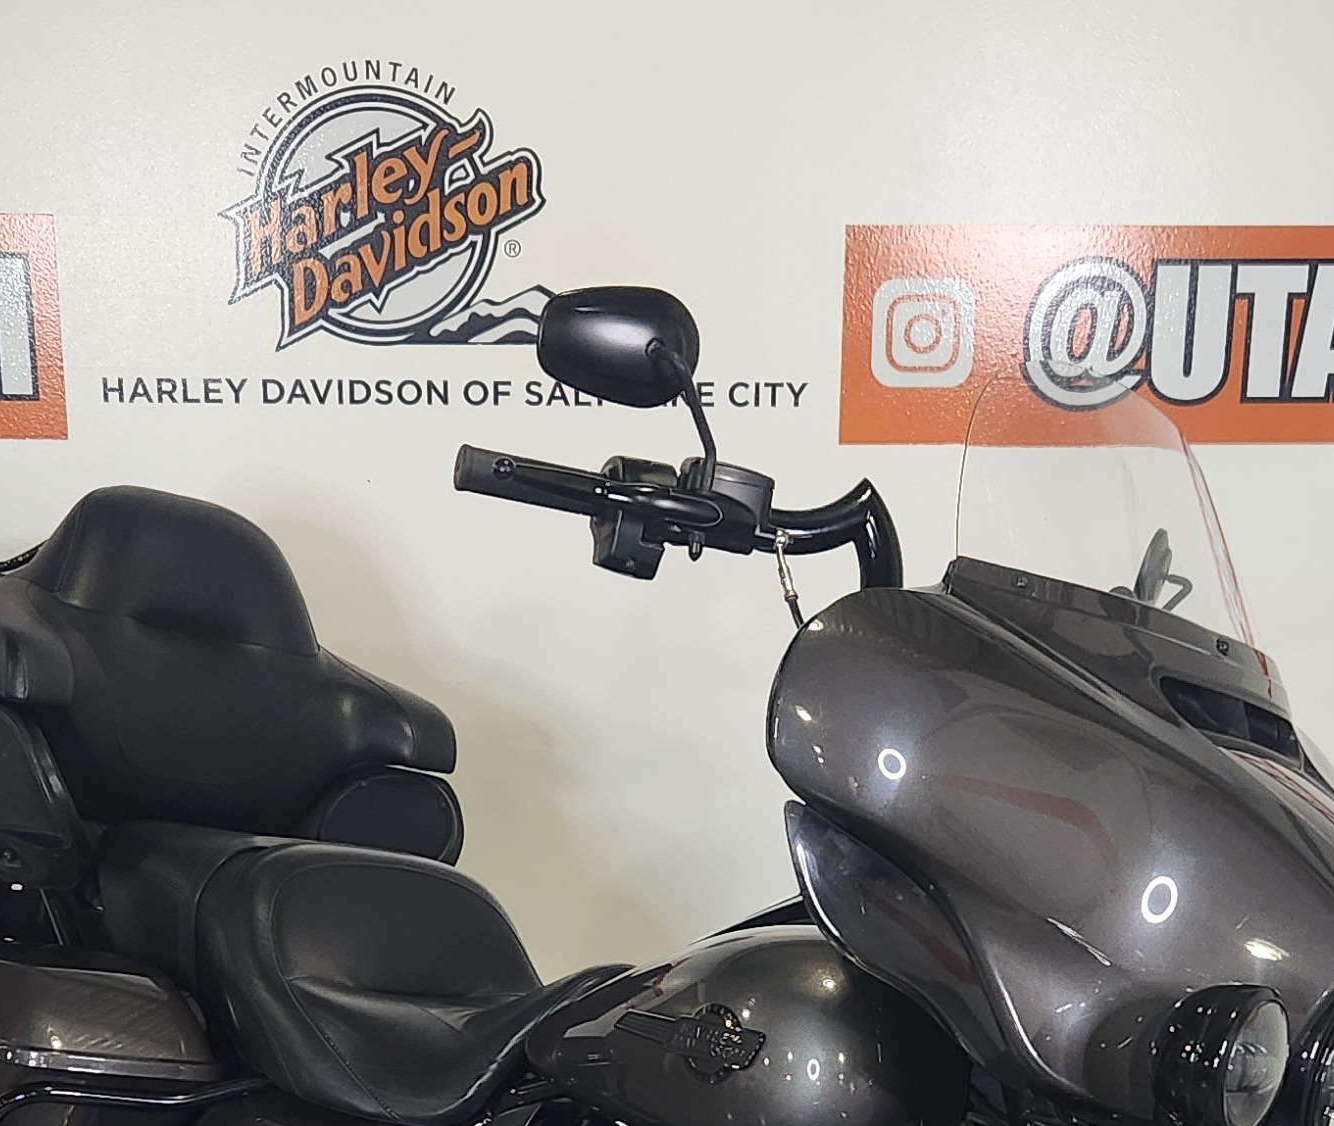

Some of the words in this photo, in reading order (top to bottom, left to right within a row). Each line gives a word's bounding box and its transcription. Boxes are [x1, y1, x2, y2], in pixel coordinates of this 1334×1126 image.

[237, 59, 457, 178] INTERMOUNTAIN
[289, 160, 533, 330] Davidson
[101, 377, 249, 405] HARLEY
[261, 378, 451, 406] DAVIDSON
[463, 379, 512, 407] OF
[728, 381, 809, 409] CITY
